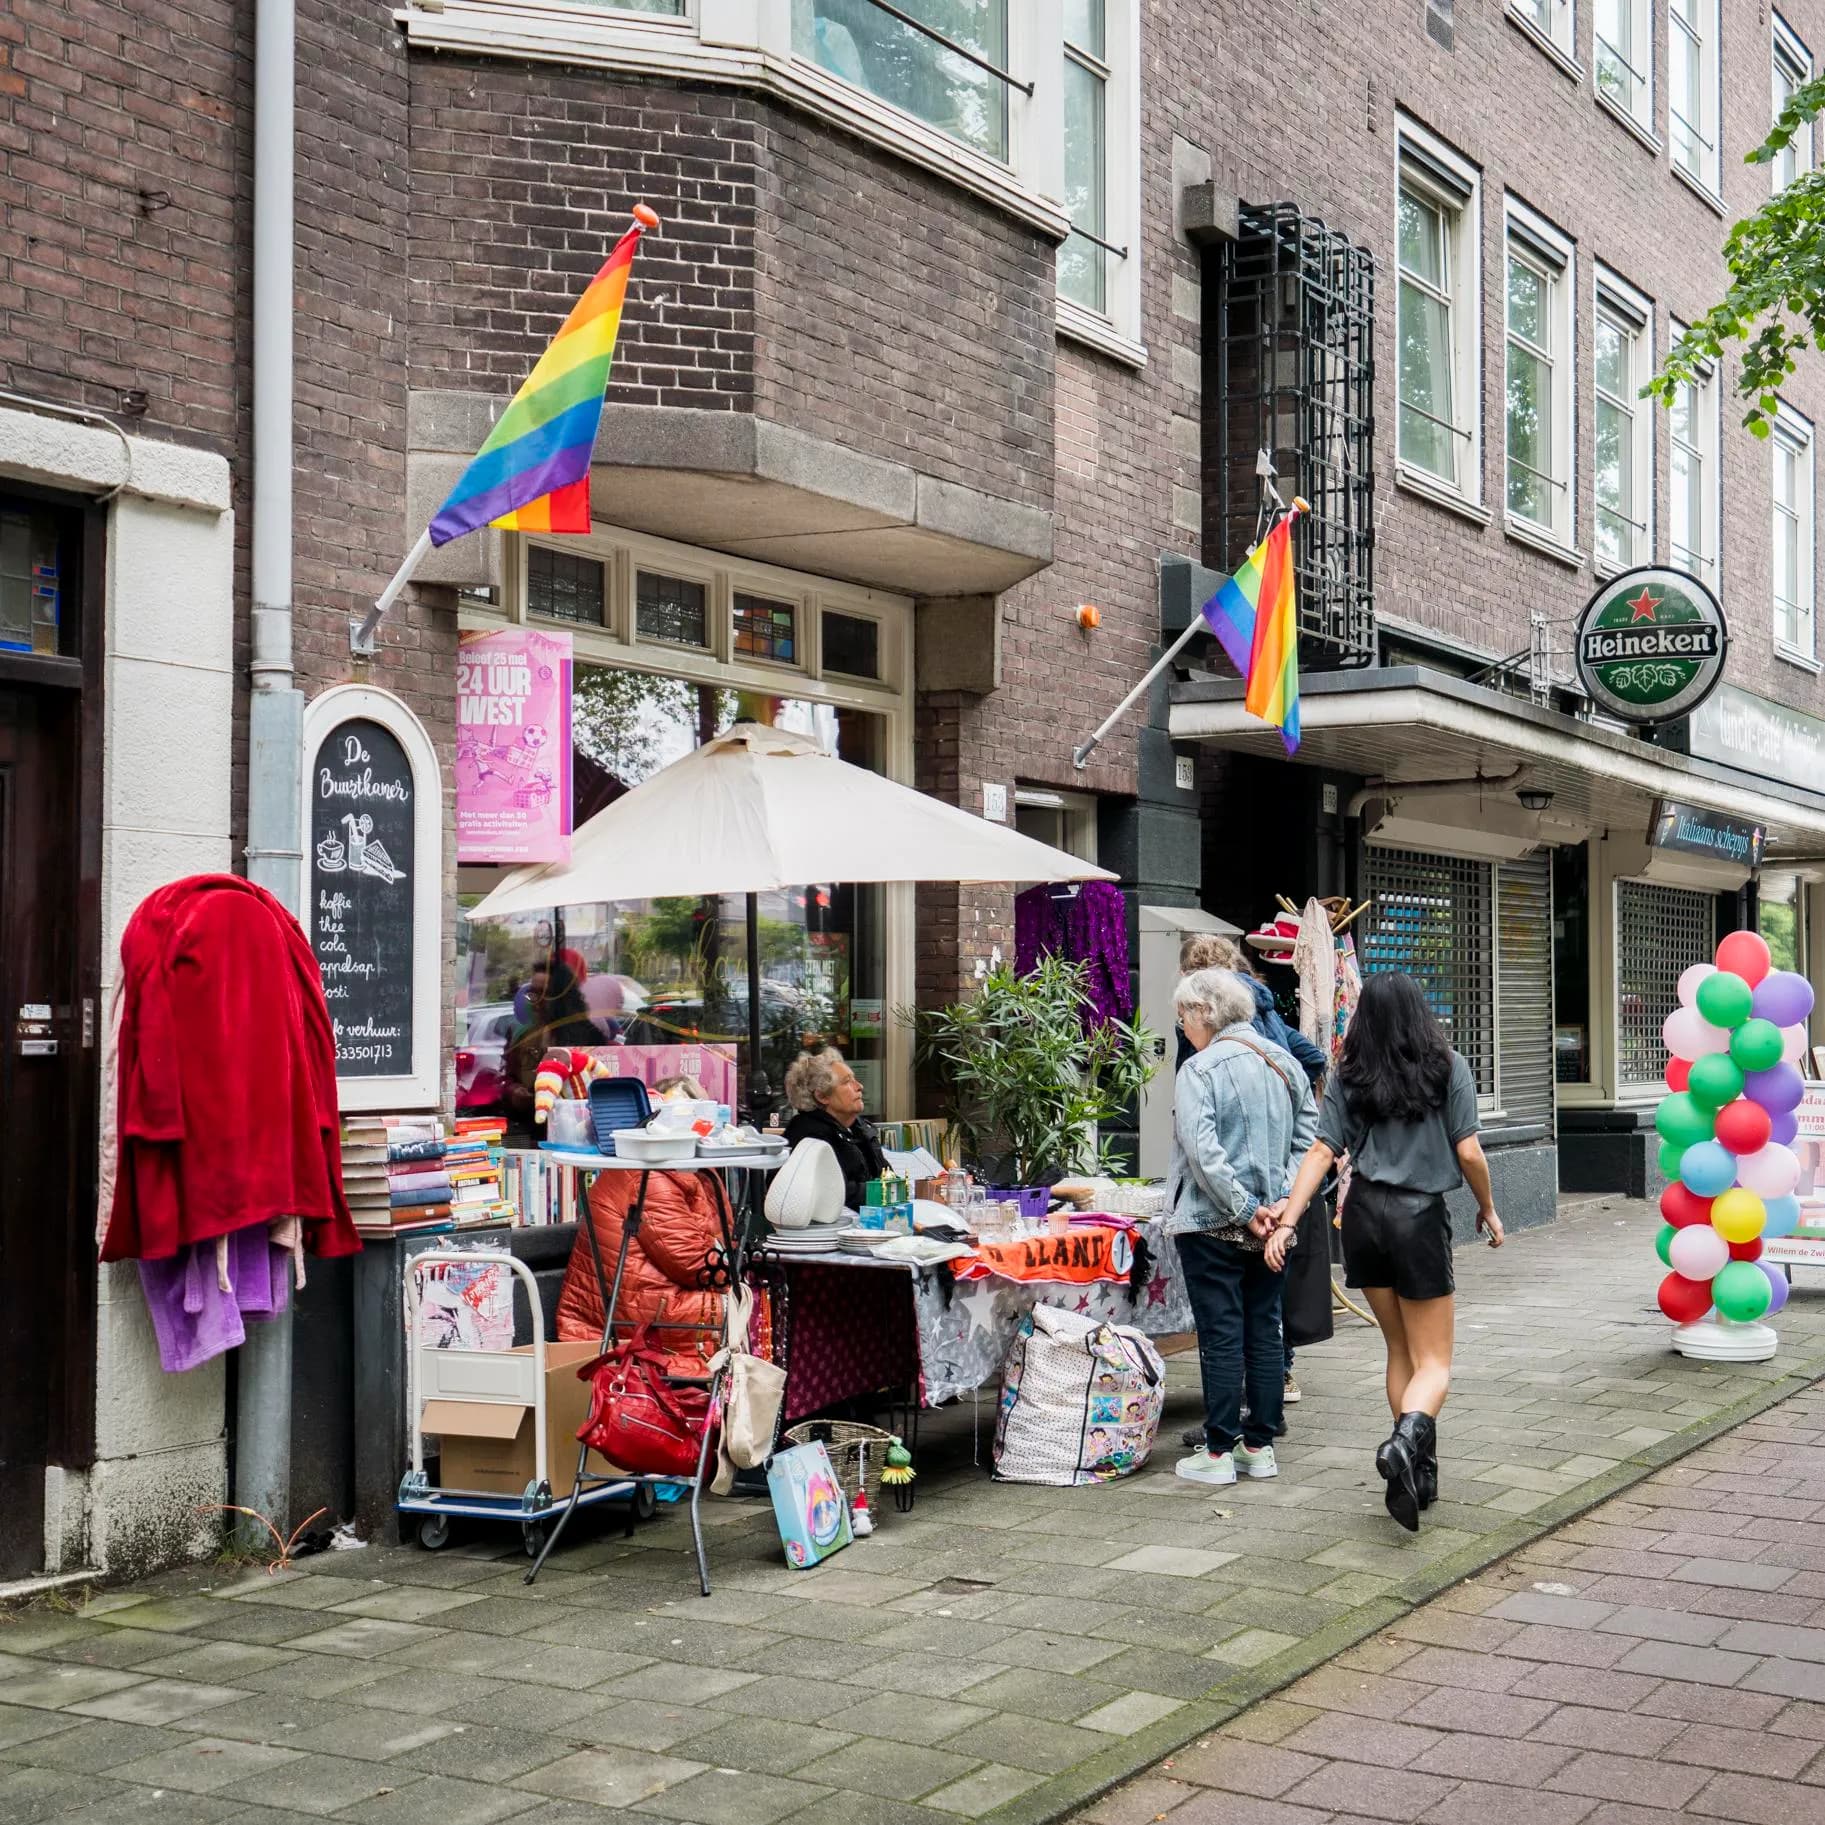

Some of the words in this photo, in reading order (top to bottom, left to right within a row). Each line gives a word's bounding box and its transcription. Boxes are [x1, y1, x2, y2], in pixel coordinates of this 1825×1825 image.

[459, 651, 491, 665] Beleef
[1587, 629, 1711, 659] Heineken
[457, 665, 483, 694] 24
[488, 665, 531, 695] UUR
[460, 695, 525, 726] WEST
[344, 735, 371, 766] De
[1676, 815, 1716, 846] Italiaans
[1715, 825, 1749, 859] schepijs
[319, 889, 352, 919] koffie
[319, 915, 346, 932] thee
[319, 954, 375, 981] appelsap
[1768, 1246, 1796, 1256] Willem
[1798, 1248, 1809, 1256] de
